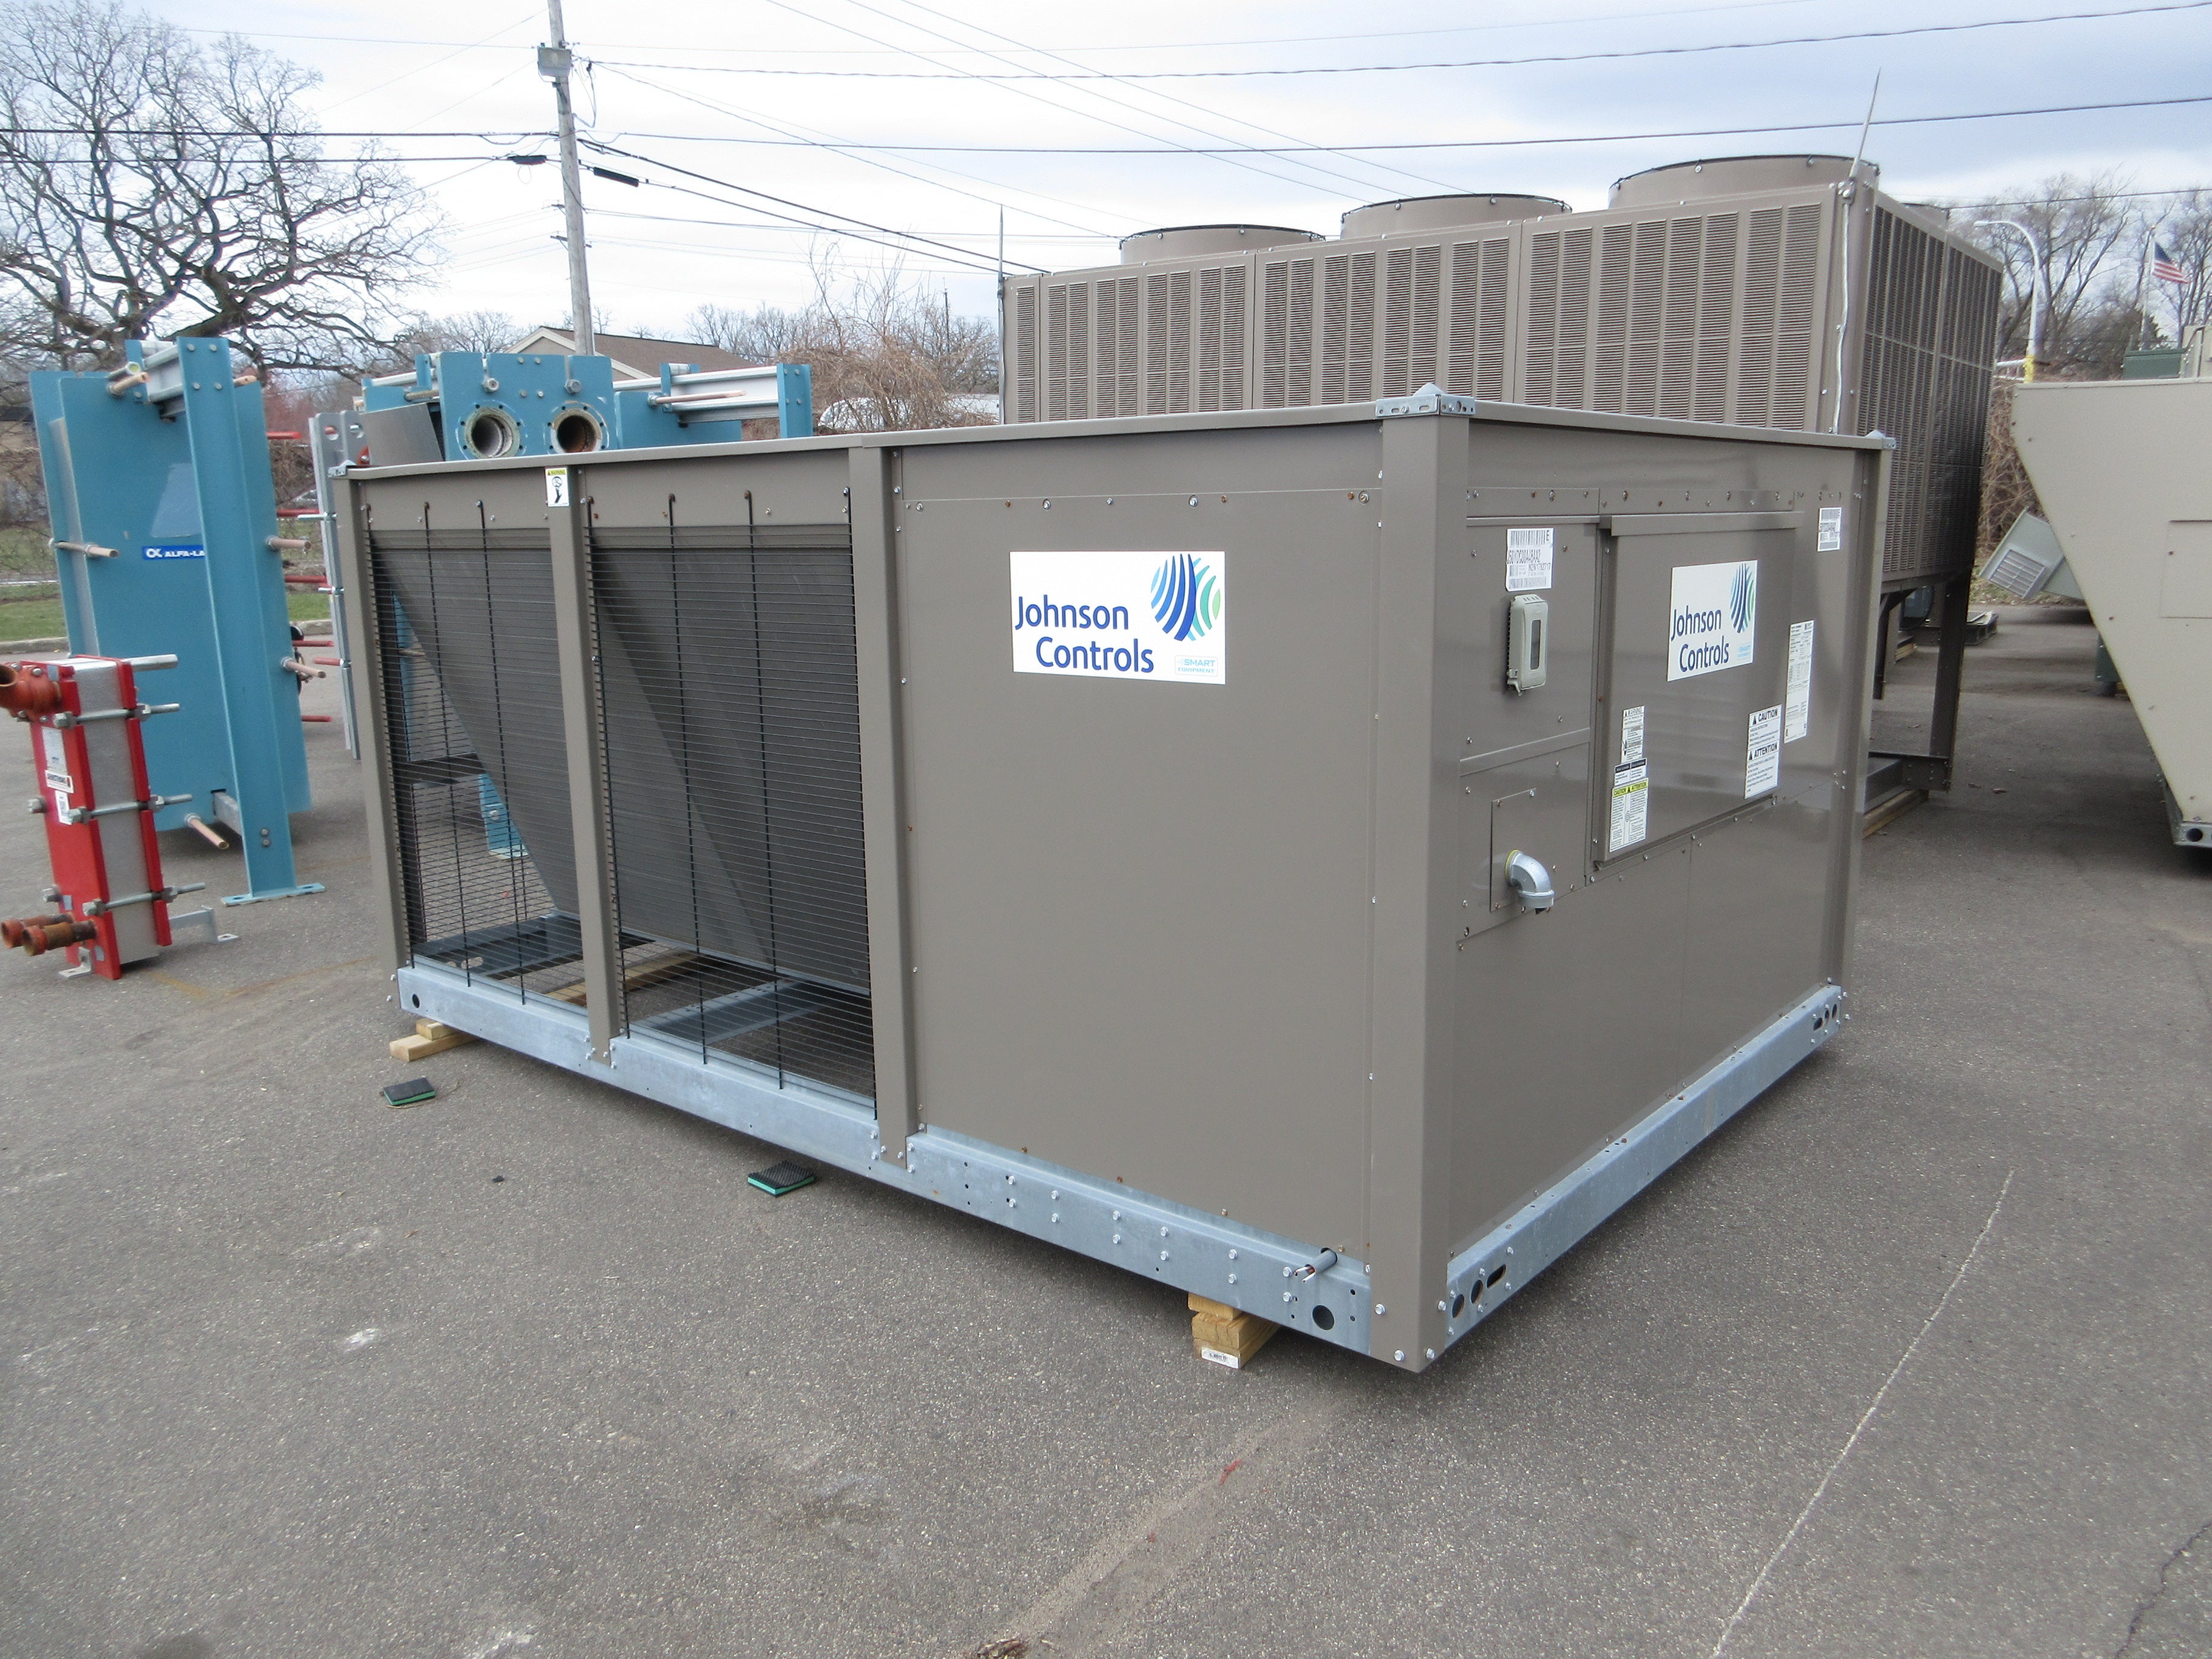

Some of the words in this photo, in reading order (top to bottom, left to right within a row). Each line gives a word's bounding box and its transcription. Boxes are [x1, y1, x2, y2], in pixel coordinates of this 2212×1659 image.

[1015, 594, 1128, 630] Johnson
[1671, 605, 1721, 642] Johnson
[1036, 636, 1154, 673] Controls
[1184, 659, 1215, 667] SMART
[1680, 635, 1729, 672] Controls
[1758, 708, 1778, 722] CAUTION
[1754, 742, 1778, 759] ATTENTION
[1614, 788, 1626, 796] CAUTION
[1632, 782, 1646, 790] ATTENTION
